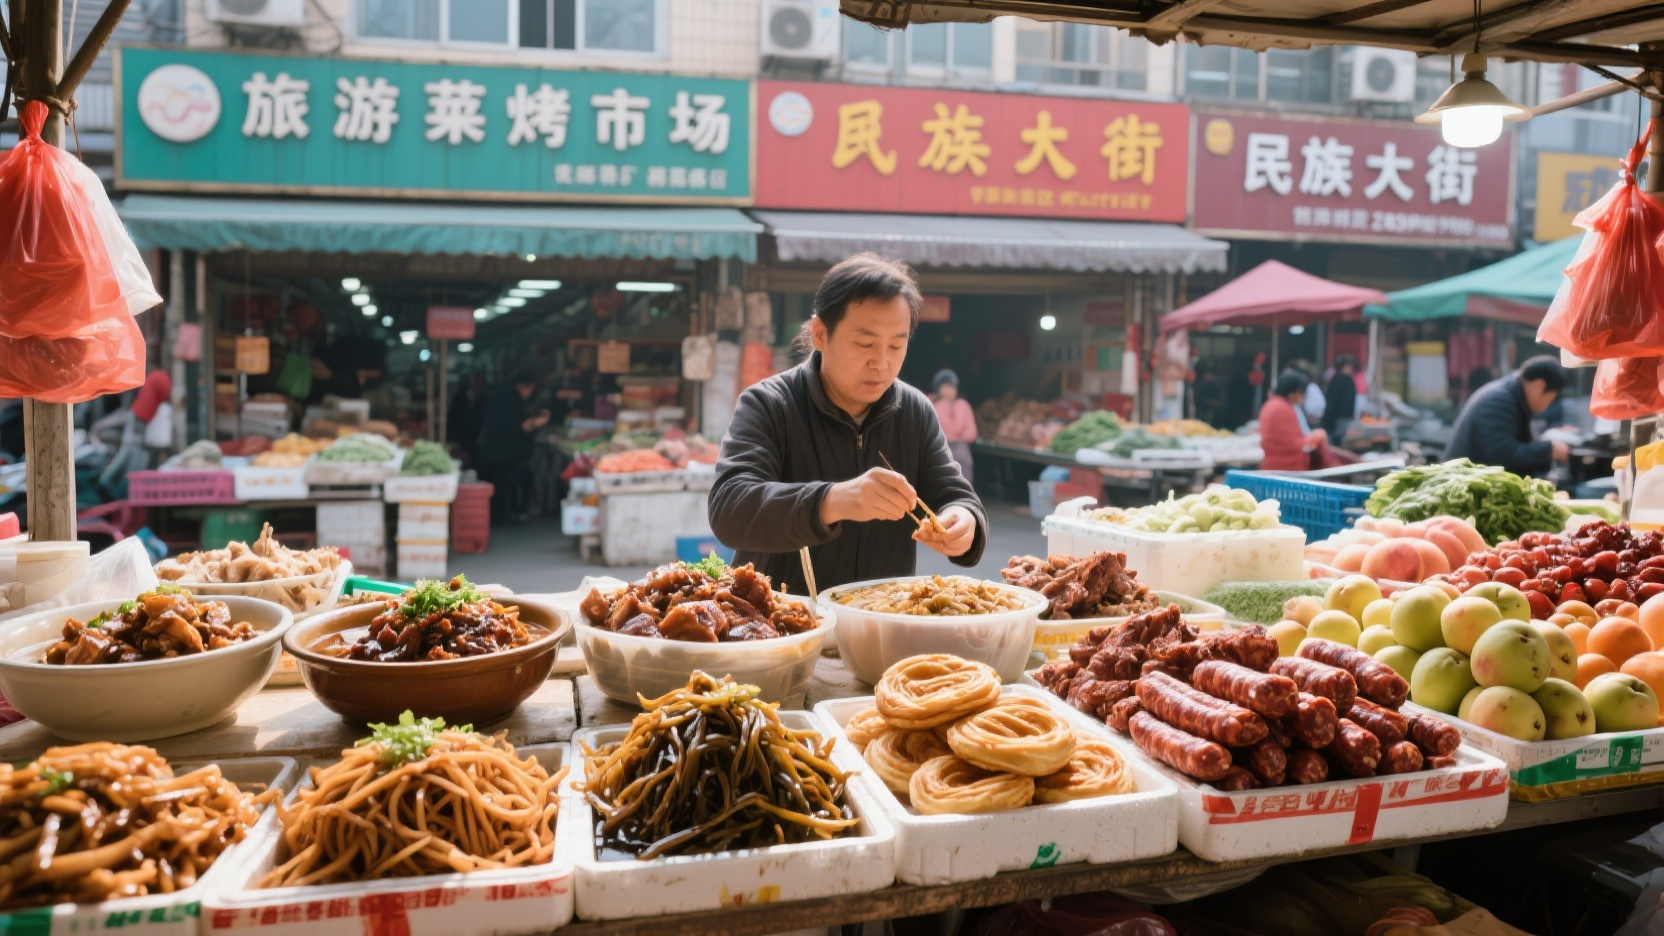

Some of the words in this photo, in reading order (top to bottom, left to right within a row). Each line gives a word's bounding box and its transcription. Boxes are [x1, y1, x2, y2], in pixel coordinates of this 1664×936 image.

[832, 100, 1164, 185] 民族大街
[1243, 132, 1478, 206] 民族大街
